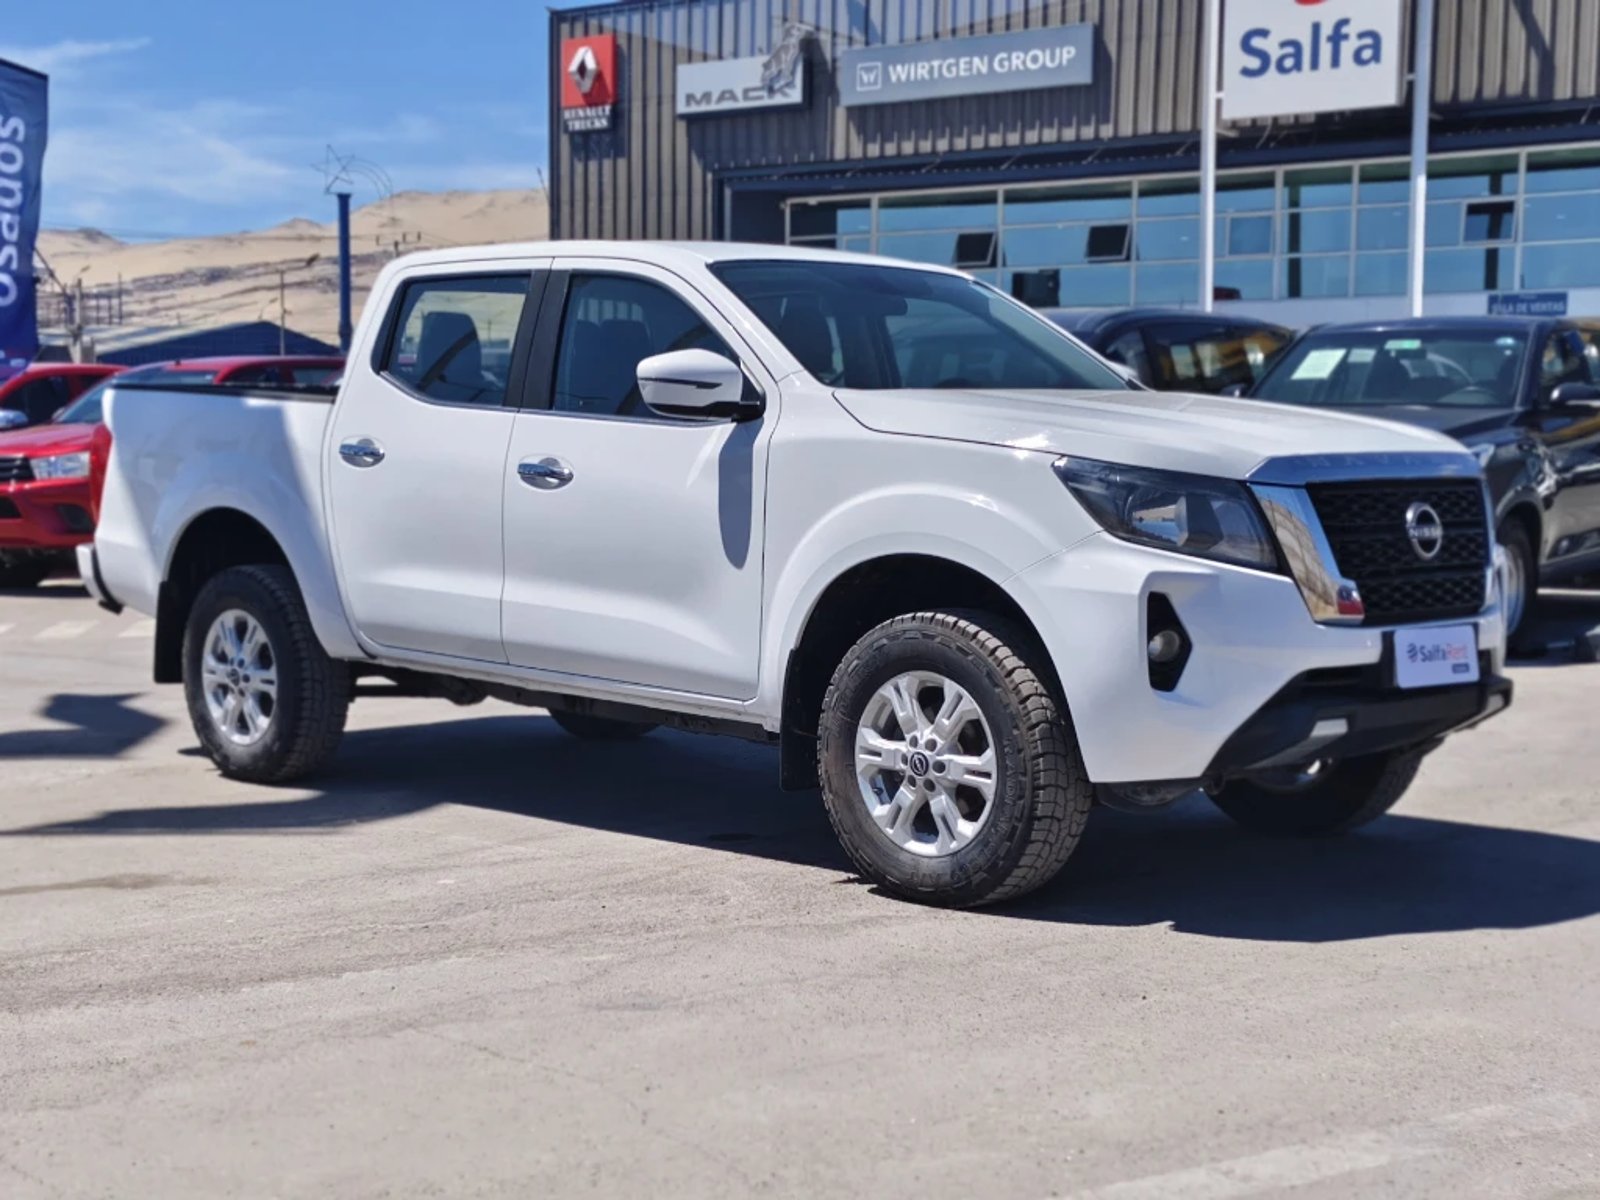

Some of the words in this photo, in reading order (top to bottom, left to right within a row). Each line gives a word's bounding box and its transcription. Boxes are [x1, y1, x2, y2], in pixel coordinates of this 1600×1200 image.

[1239, 18, 1382, 78] Salfa
[888, 54, 989, 84] WIRTGEN
[993, 45, 1076, 73] GROUP
[685, 82, 793, 107] MACK
[567, 117, 608, 131] TRUCKS
